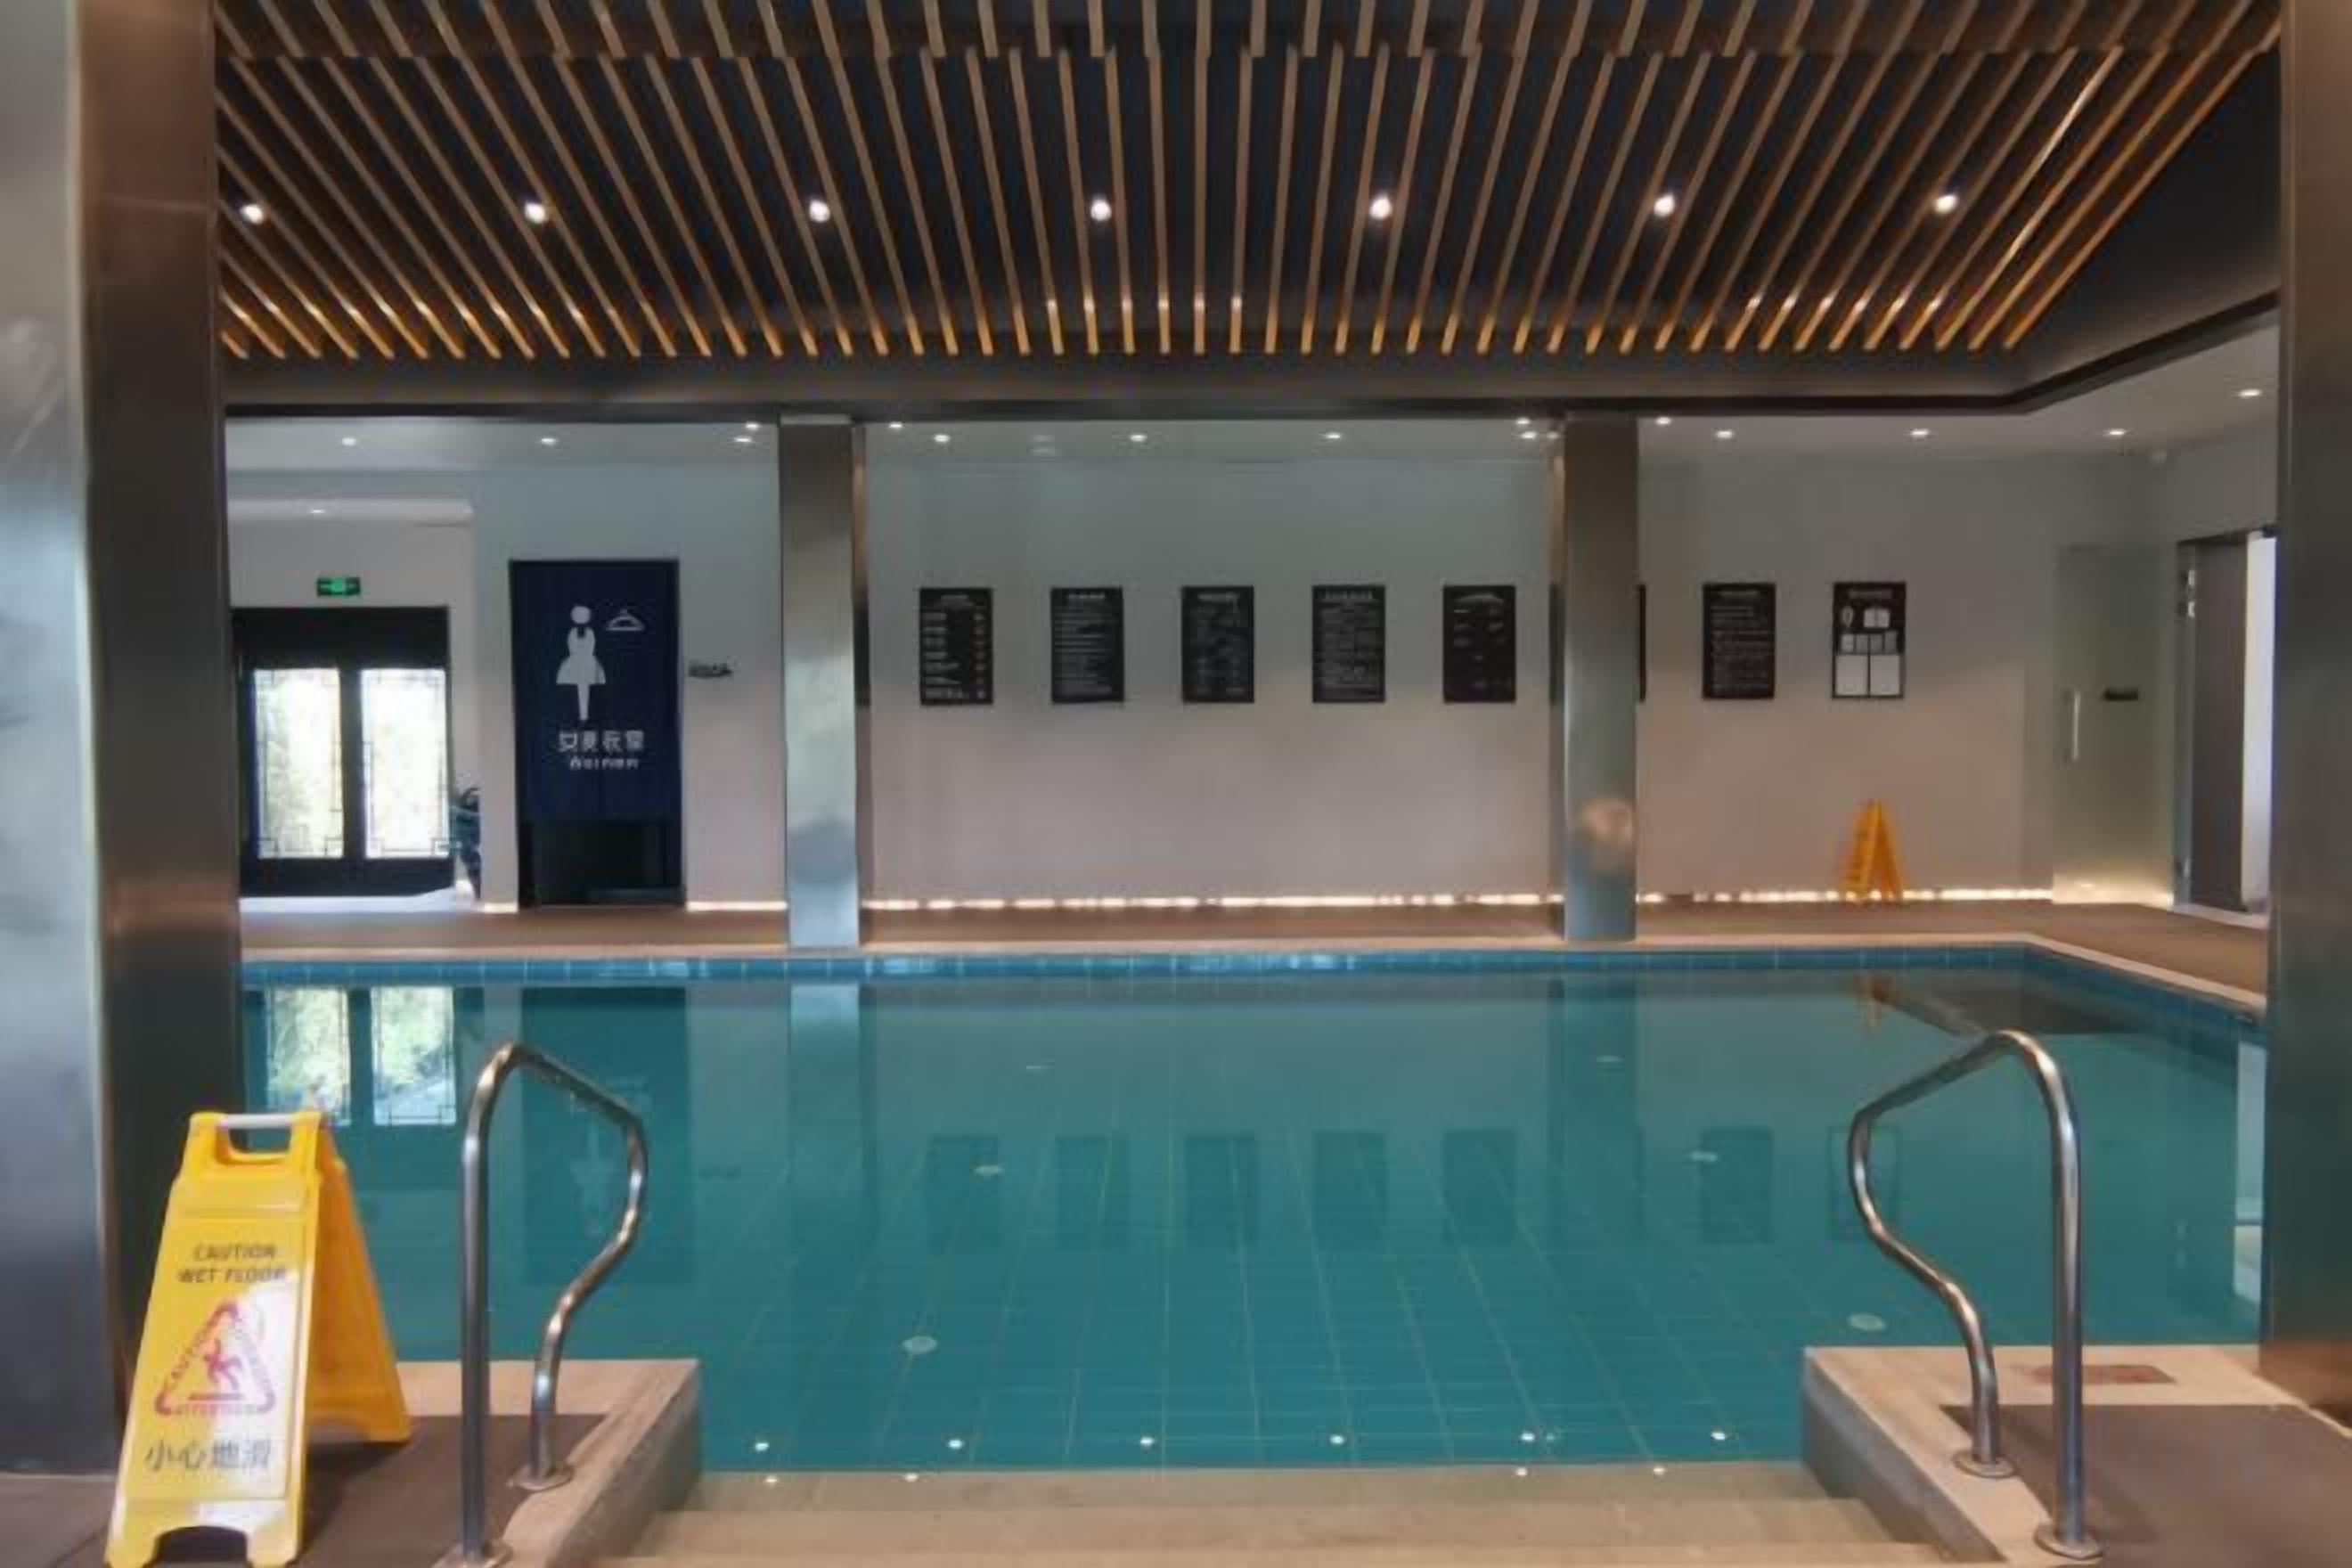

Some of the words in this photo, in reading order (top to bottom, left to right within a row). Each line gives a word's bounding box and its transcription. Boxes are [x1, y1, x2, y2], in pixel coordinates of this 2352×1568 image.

[192, 1243, 277, 1262] CAUTION
[177, 1268, 219, 1283] WET
[225, 1268, 287, 1283] FLOOR
[144, 1438, 272, 1472] 小心地滑
